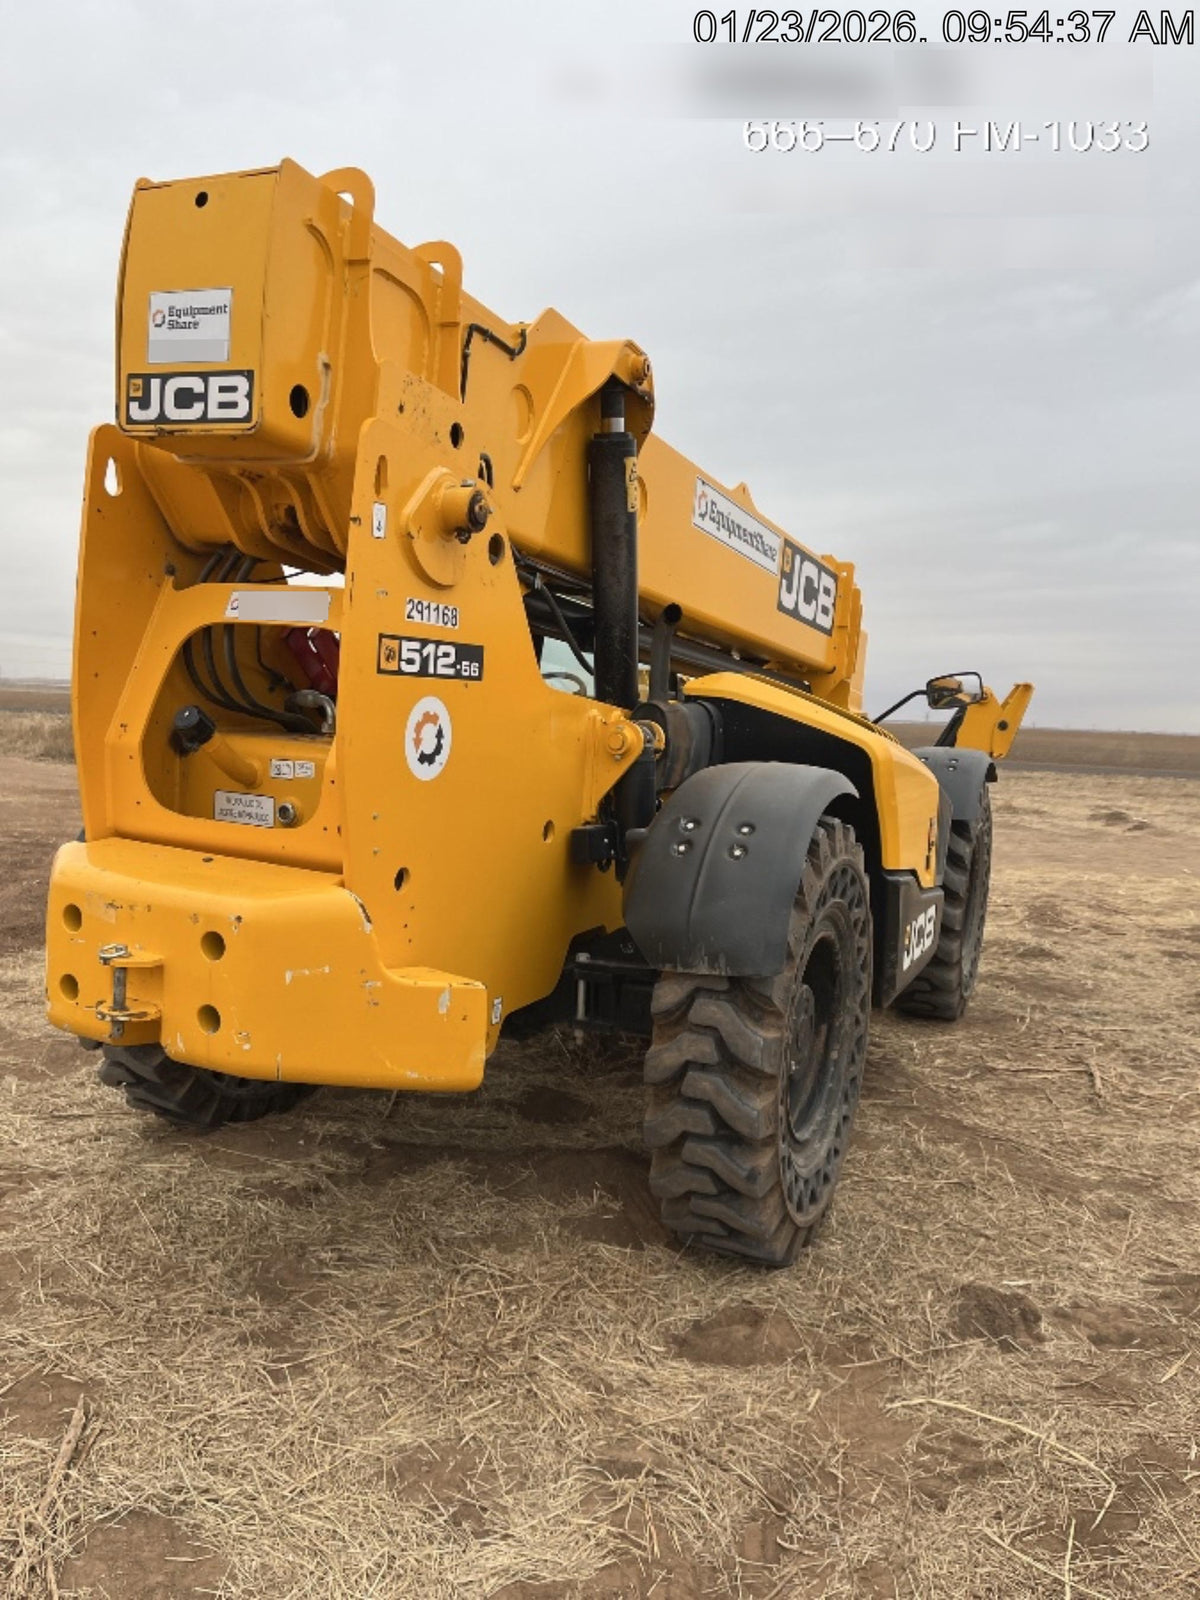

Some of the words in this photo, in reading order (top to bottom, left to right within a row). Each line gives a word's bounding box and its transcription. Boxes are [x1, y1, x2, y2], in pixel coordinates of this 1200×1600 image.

[167, 303, 229, 319] Equipment
[167, 318, 200, 331] Share
[129, 375, 250, 421] JCB
[780, 553, 836, 630] JCB
[406, 598, 458, 627] 291168
[902, 904, 936, 971] JCB
